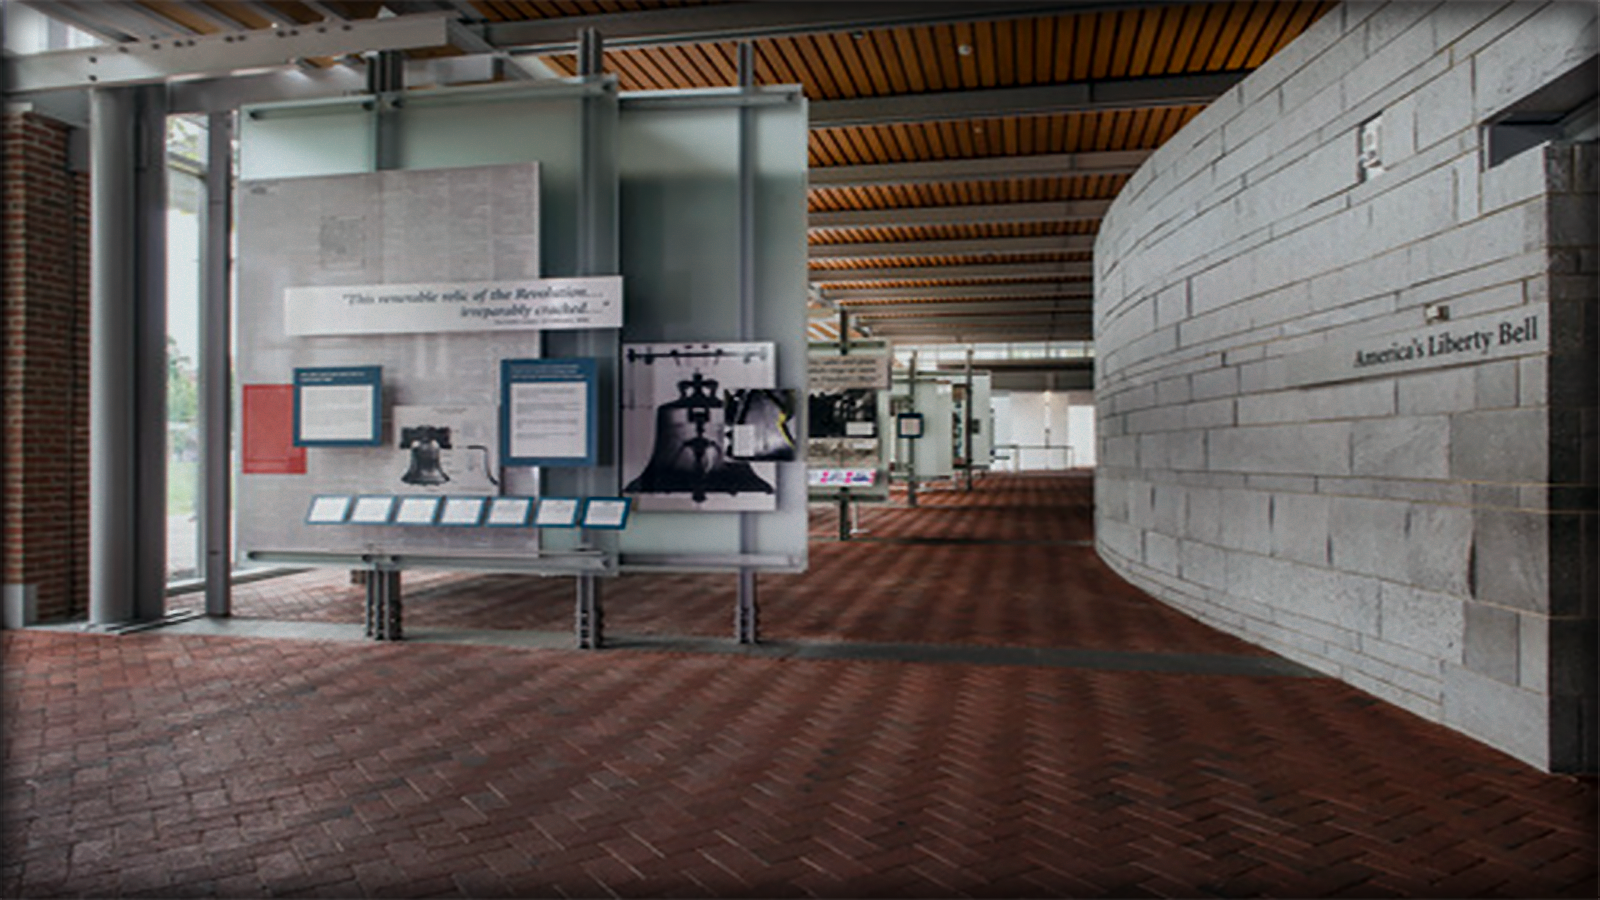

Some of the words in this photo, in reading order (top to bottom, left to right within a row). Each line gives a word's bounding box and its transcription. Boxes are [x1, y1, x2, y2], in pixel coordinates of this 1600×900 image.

[473, 289, 488, 303] of
[491, 288, 512, 300] the
[1354, 338, 1425, 368] America's
[1428, 331, 1494, 356] Liberty
[1499, 315, 1538, 346] Bell
